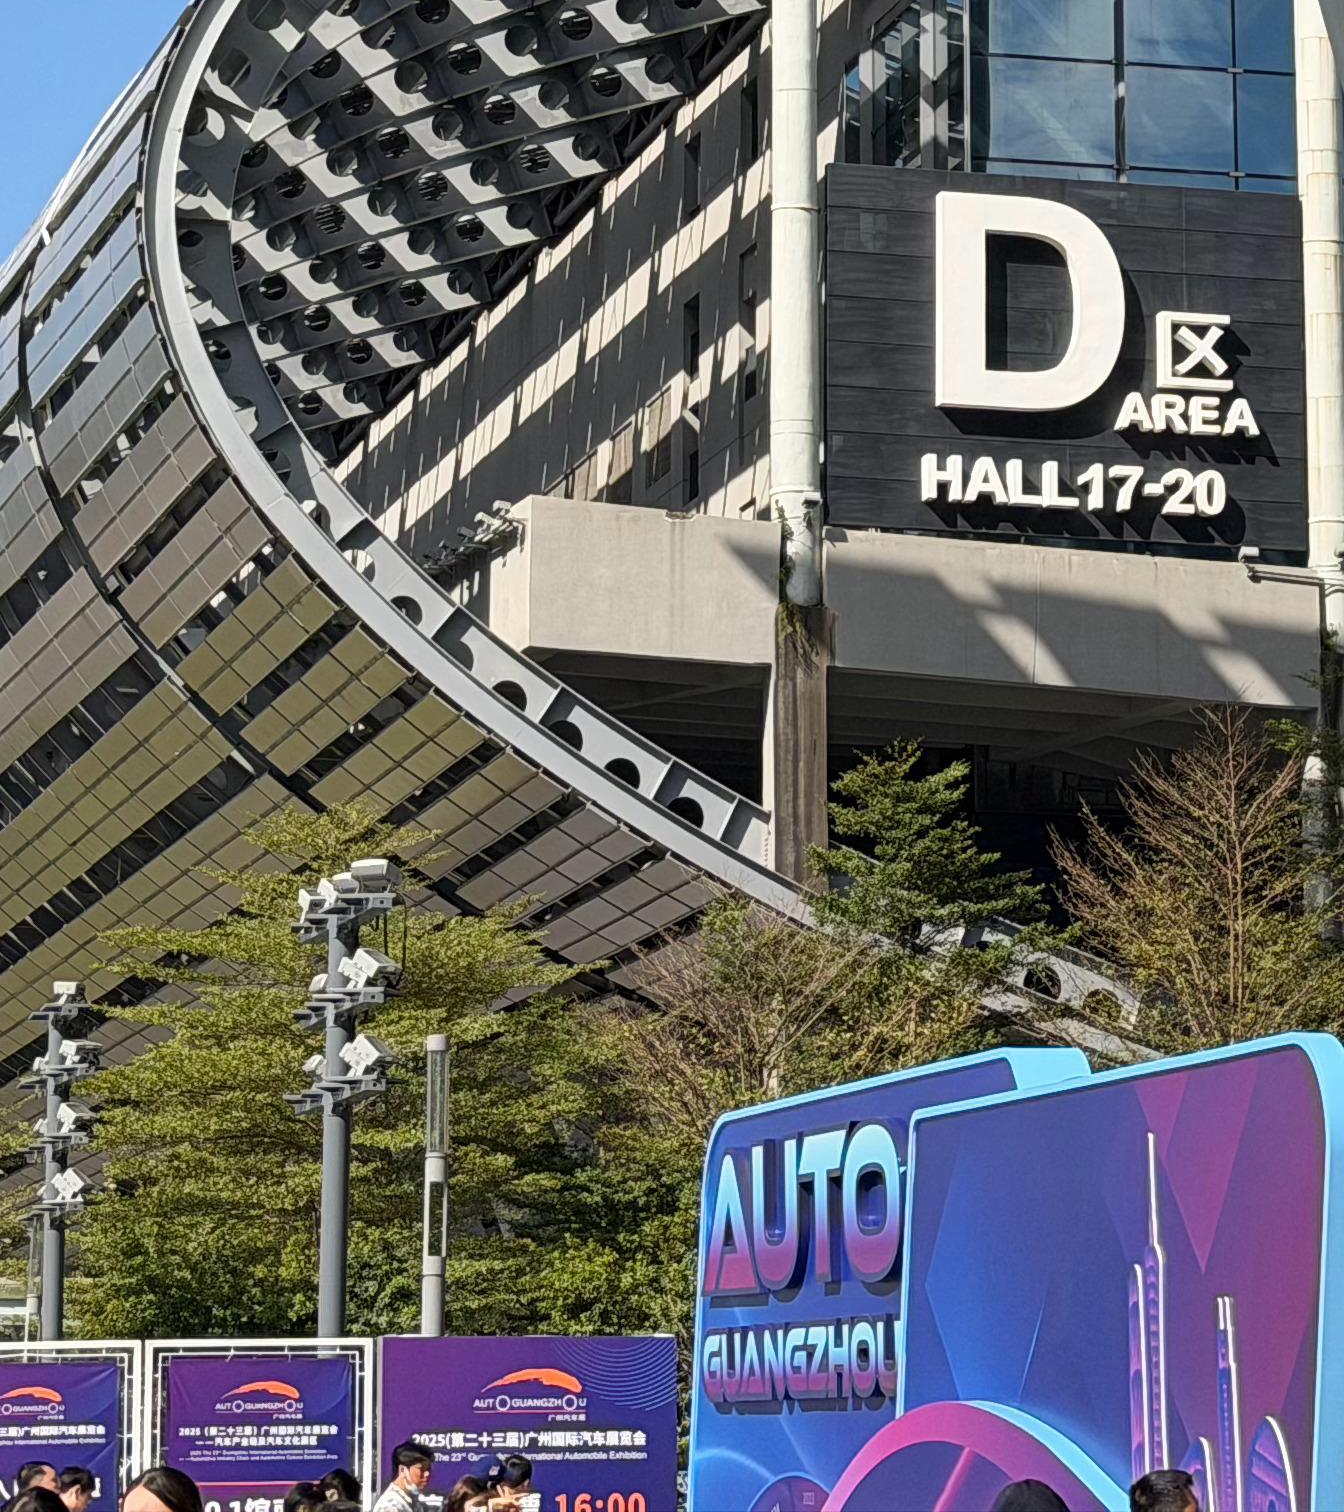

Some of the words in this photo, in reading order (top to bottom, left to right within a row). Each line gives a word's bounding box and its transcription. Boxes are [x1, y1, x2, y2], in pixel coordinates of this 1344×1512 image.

[935, 191, 1126, 411] D
[1156, 311, 1235, 391] 区
[1114, 391, 1261, 437] AREA
[703, 1123, 901, 1296] AUTO
[703, 1320, 902, 1403] GUANGZHOU
